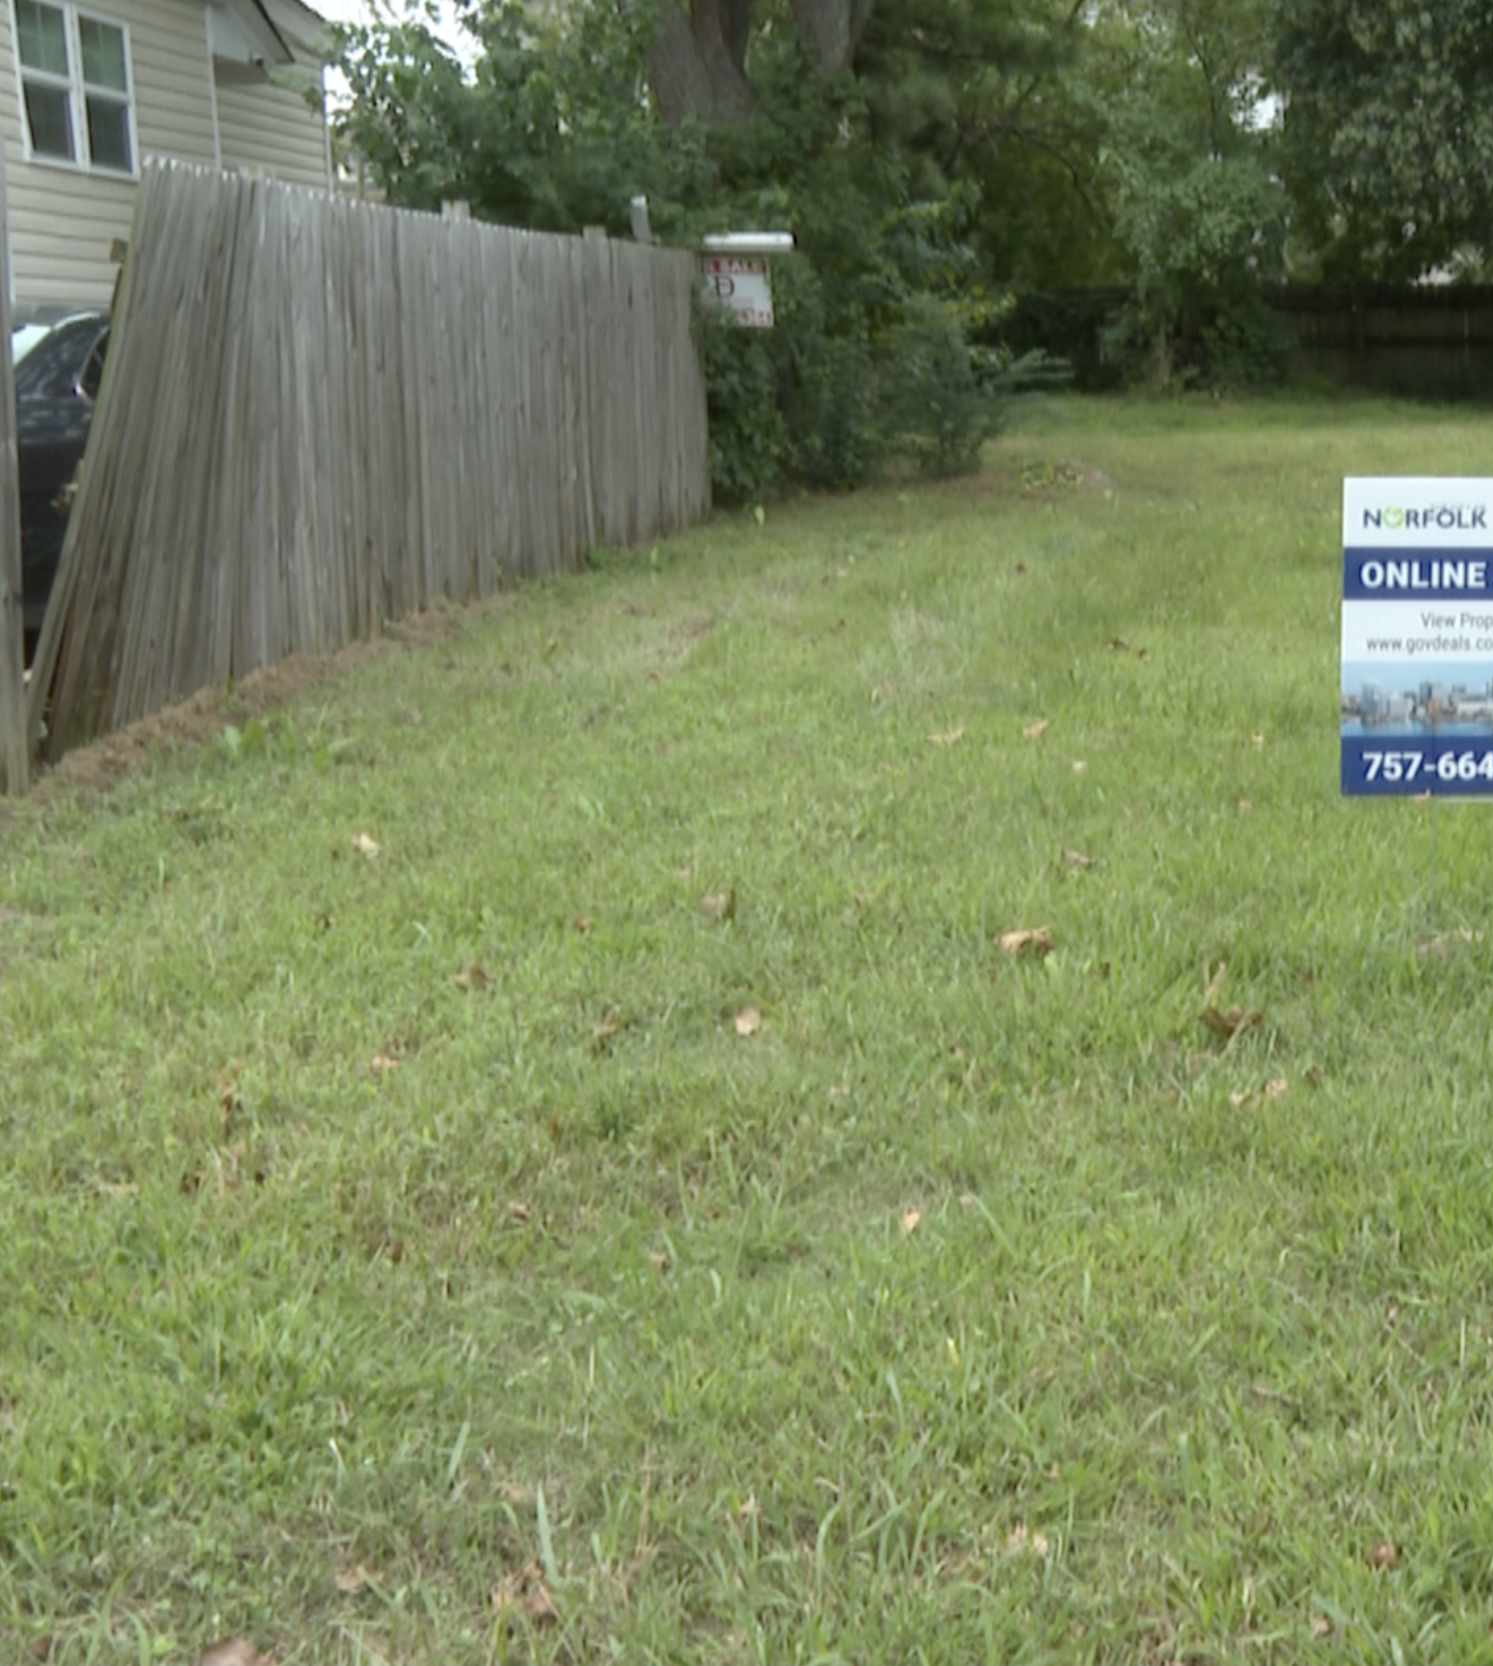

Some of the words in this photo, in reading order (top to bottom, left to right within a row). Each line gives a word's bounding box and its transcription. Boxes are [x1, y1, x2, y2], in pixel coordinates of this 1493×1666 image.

[1363, 507, 1487, 529] NORFOLK
[1361, 560, 1487, 589] ONLINE
[1421, 612, 1456, 629] View
